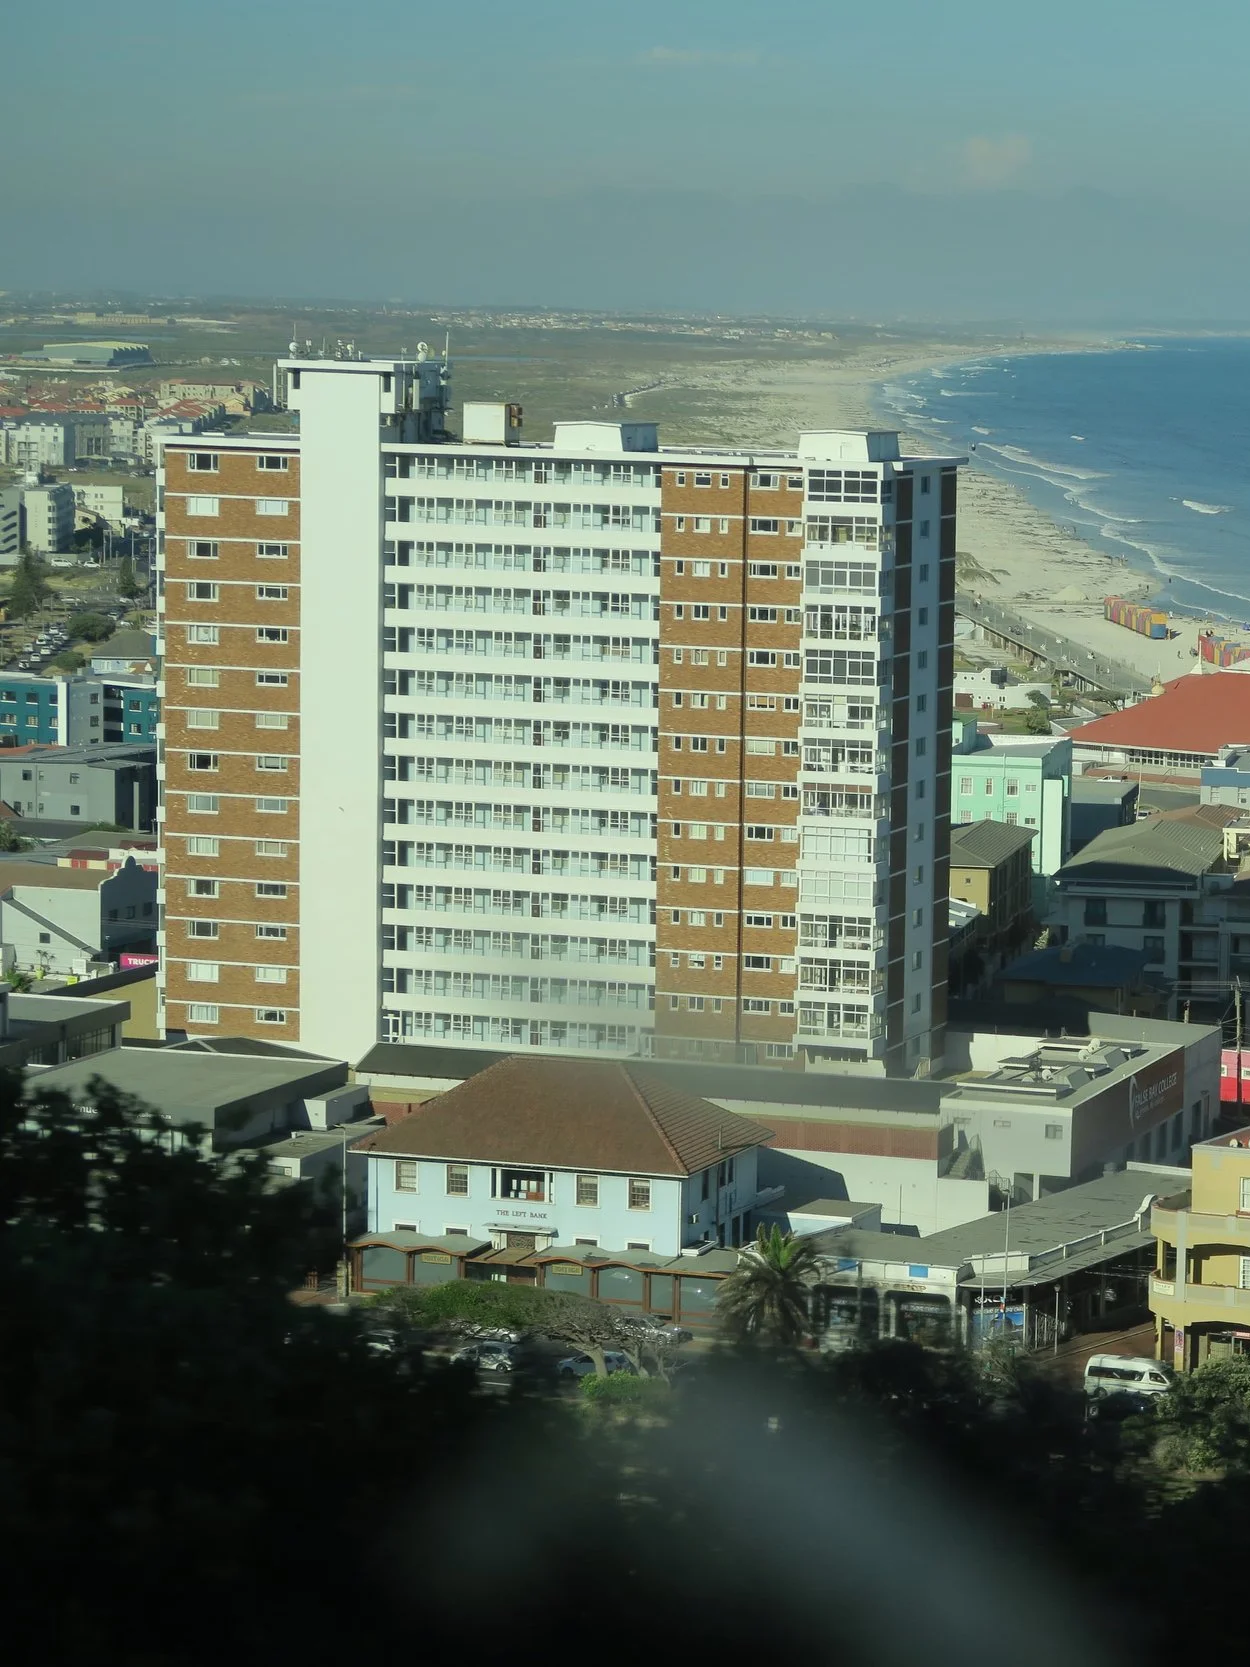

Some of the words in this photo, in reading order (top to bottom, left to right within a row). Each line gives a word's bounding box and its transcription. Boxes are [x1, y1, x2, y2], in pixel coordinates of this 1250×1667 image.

[127, 957, 159, 966] TRUCK
[496, 1209, 510, 1217] THE
[511, 1210, 527, 1218] LEFT
[529, 1211, 549, 1219] BANK
